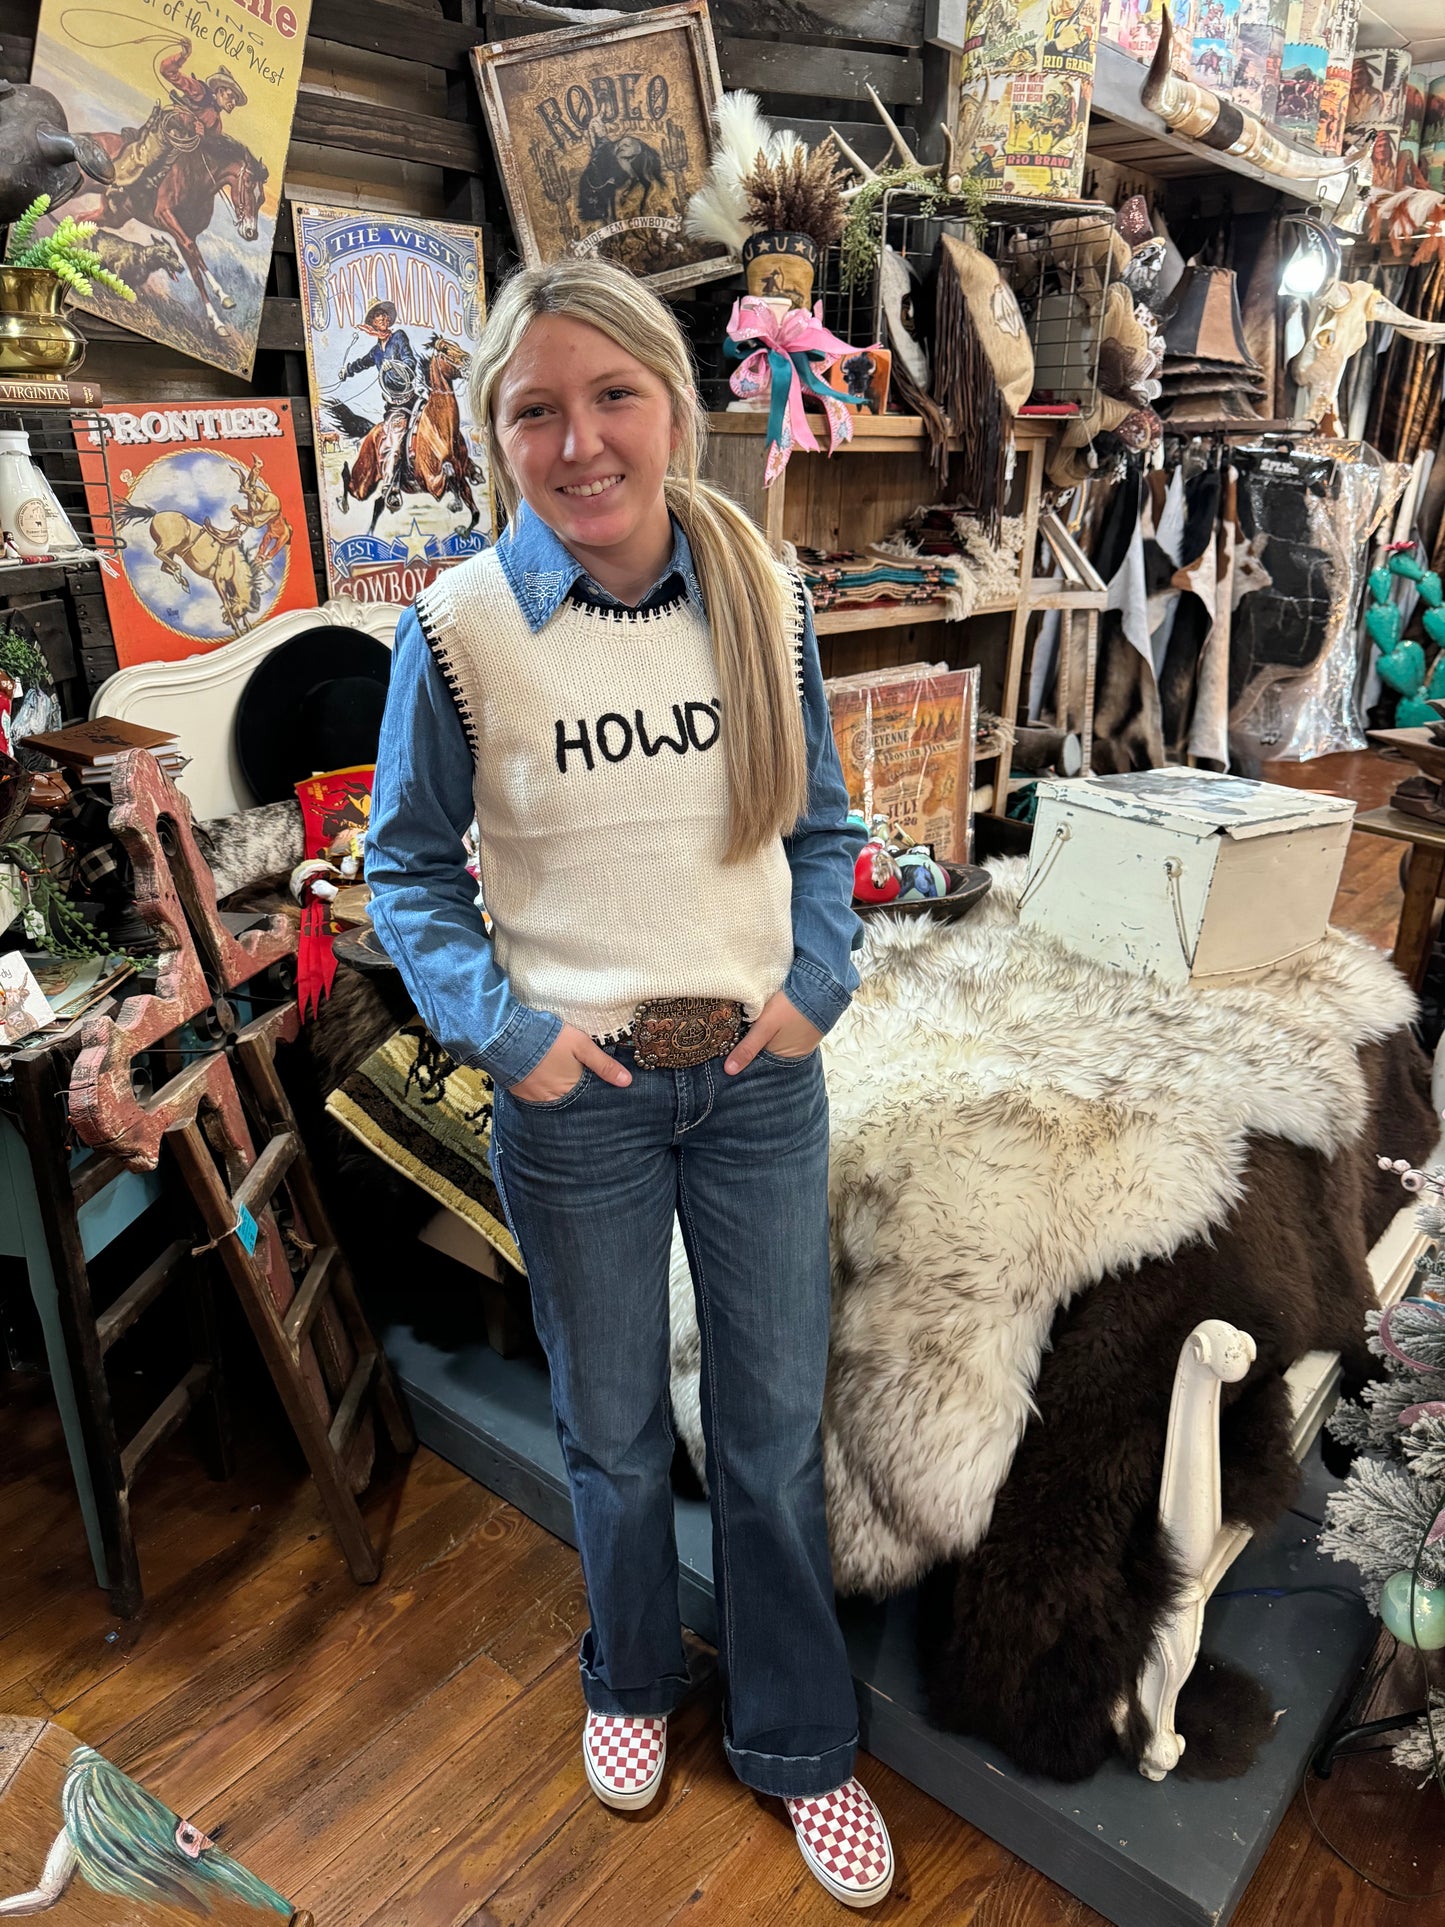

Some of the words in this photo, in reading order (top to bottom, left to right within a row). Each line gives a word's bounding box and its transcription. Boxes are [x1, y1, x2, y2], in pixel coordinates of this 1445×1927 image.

[232, 0, 297, 38] ne
[163, 0, 184, 22] of
[185, 7, 208, 40] the
[212, 26, 244, 60] Old
[246, 44, 285, 86] West
[1043, 55, 1063, 69] RIO
[534, 73, 669, 150] RODEO
[1034, 155, 1070, 168] BRAVO
[330, 227, 382, 254] THE
[388, 227, 456, 268] WEST
[583, 231, 605, 249] RIDE
[328, 252, 464, 338] WYOMING
[1, 385, 71, 401] VIRGINIAN
[87, 406, 285, 446] FRONTIER
[346, 539, 375, 559] EST.
[454, 535, 482, 551] 1890
[555, 697, 722, 774] HOWD
[886, 799, 917, 818] JULY
[650, 1003, 675, 1013] ROBY
[676, 996, 710, 1011] SADDLE
[660, 1010, 689, 1019] RANCH
[690, 1005, 719, 1016] RODEO
[667, 1047, 711, 1060] CHAMPION
